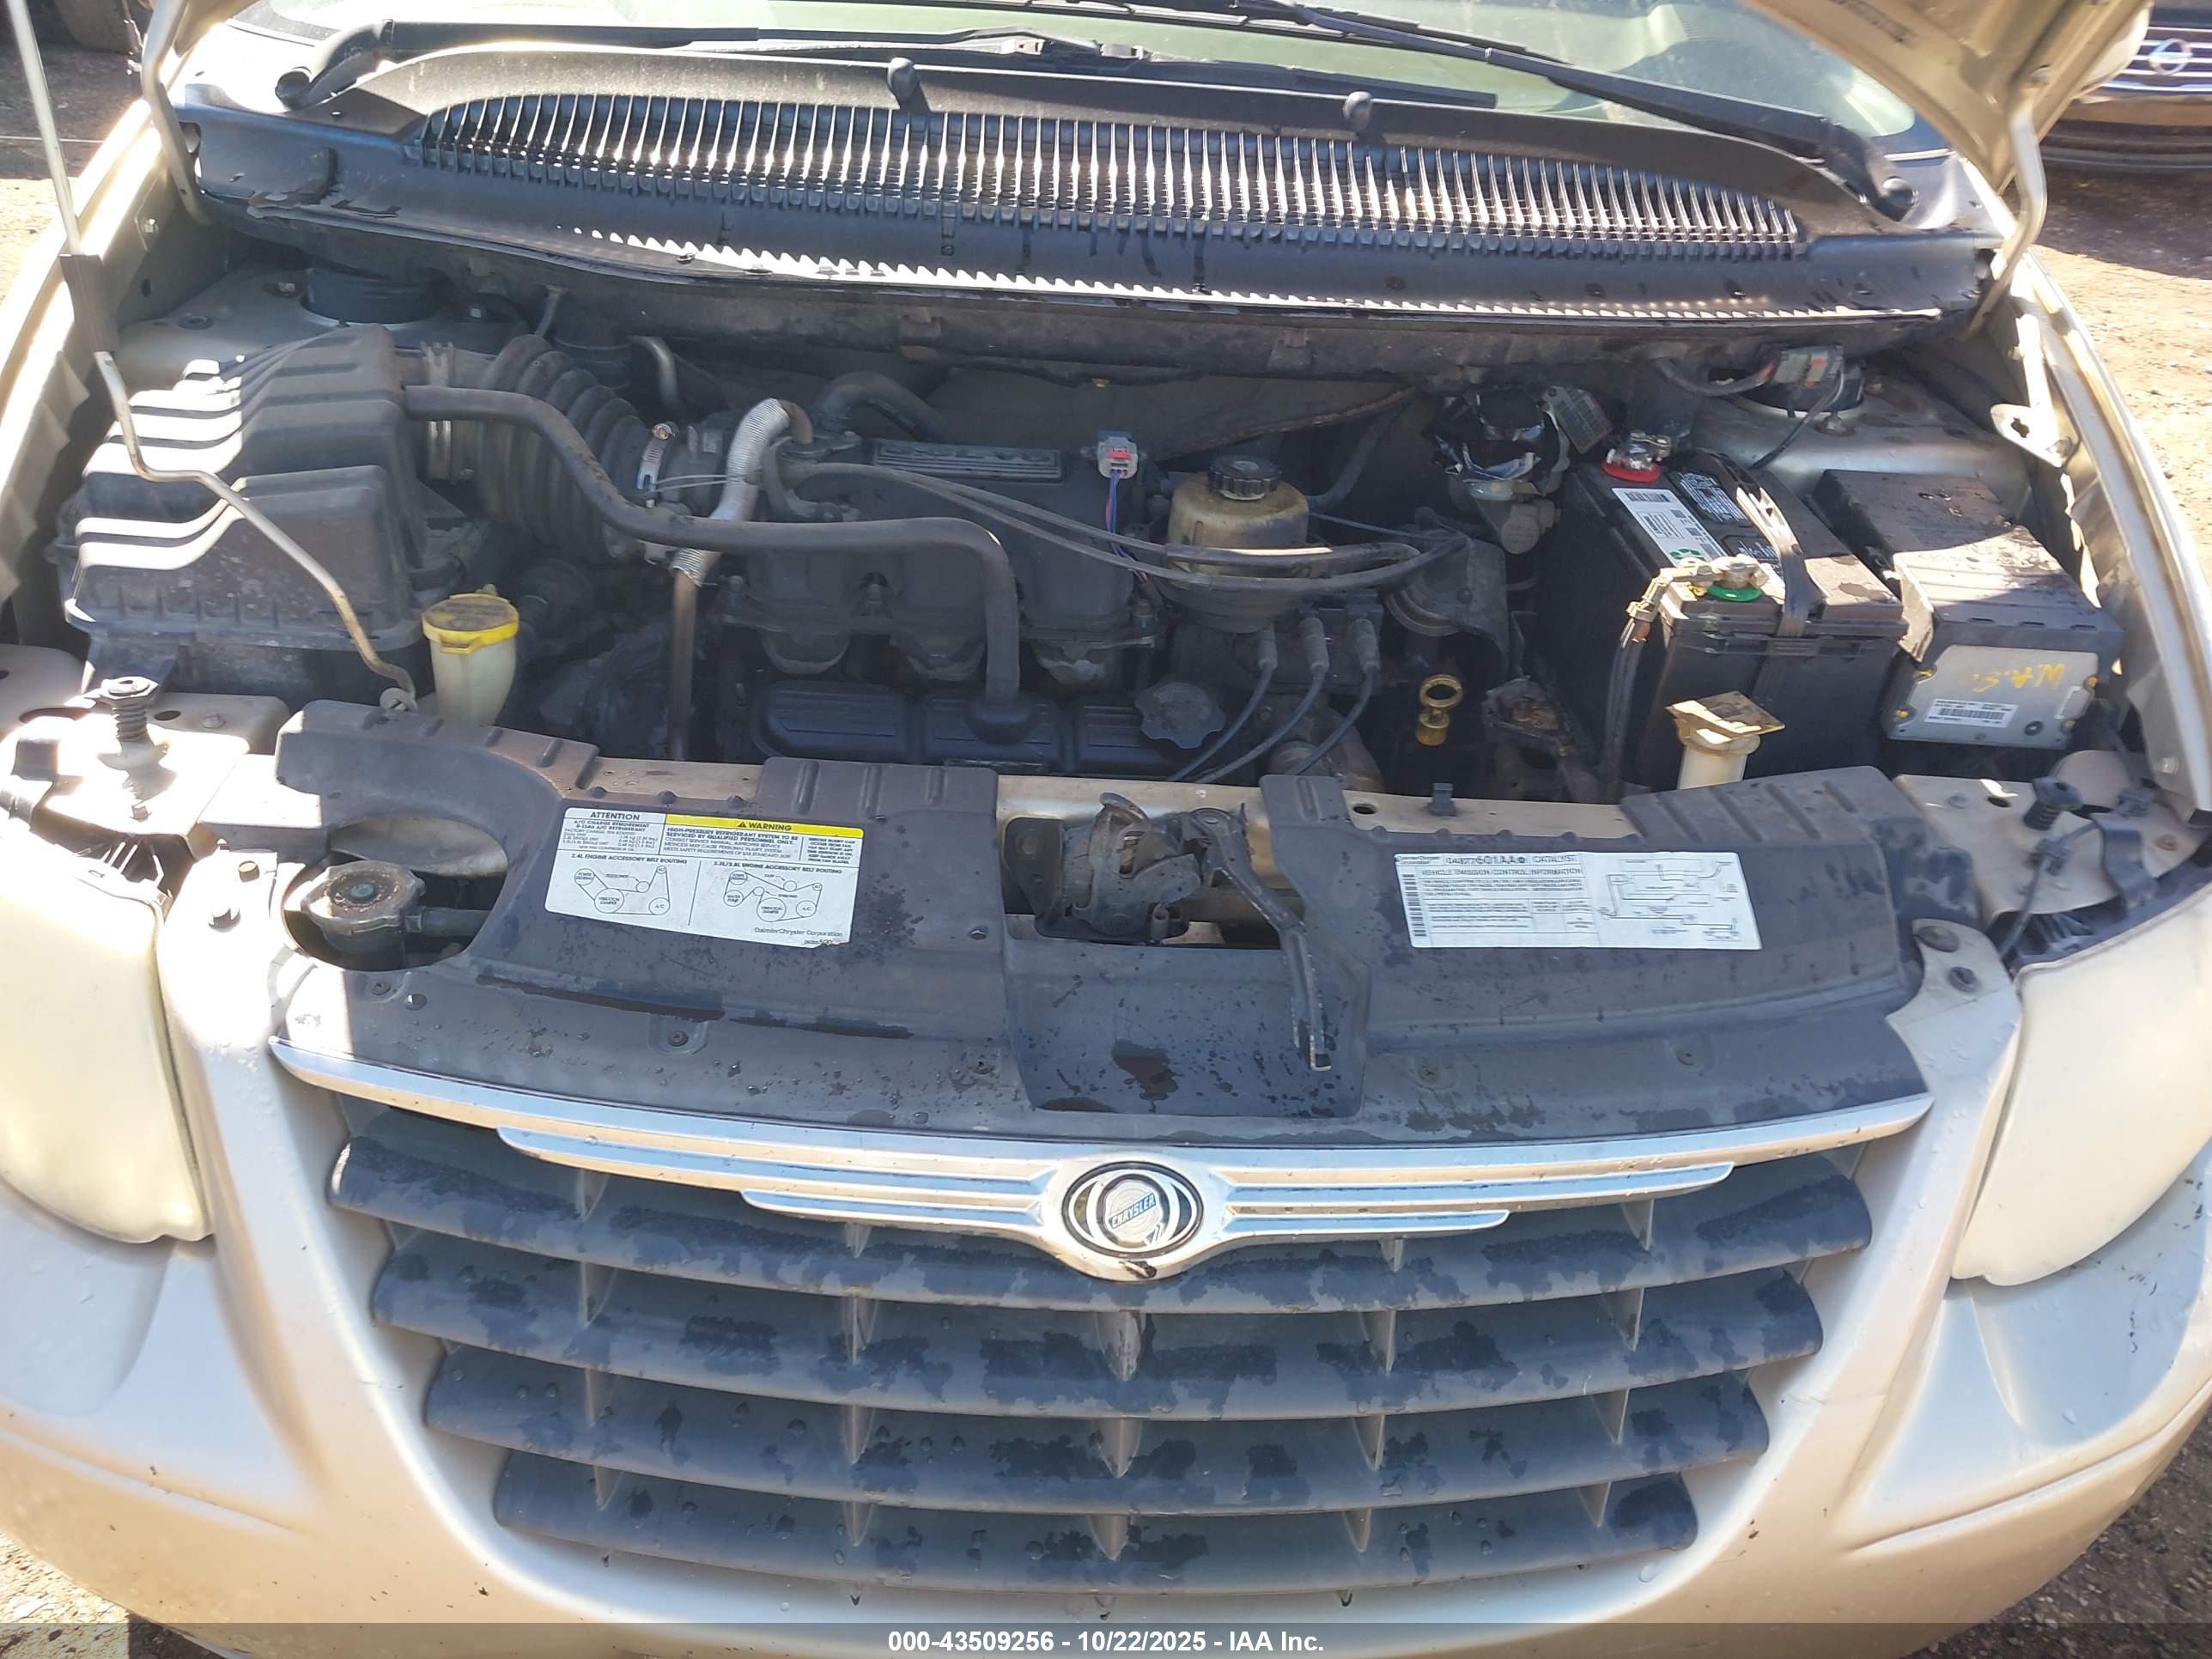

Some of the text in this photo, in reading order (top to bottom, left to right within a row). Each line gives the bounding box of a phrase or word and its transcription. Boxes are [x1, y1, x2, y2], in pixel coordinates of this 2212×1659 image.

[590, 811, 640, 821] ATTENTION
[749, 822, 792, 831] WARNING
[754, 927, 843, 939] DaimlerChrysler Corporation
[1111, 1193, 1156, 1228] CHRYSLER
